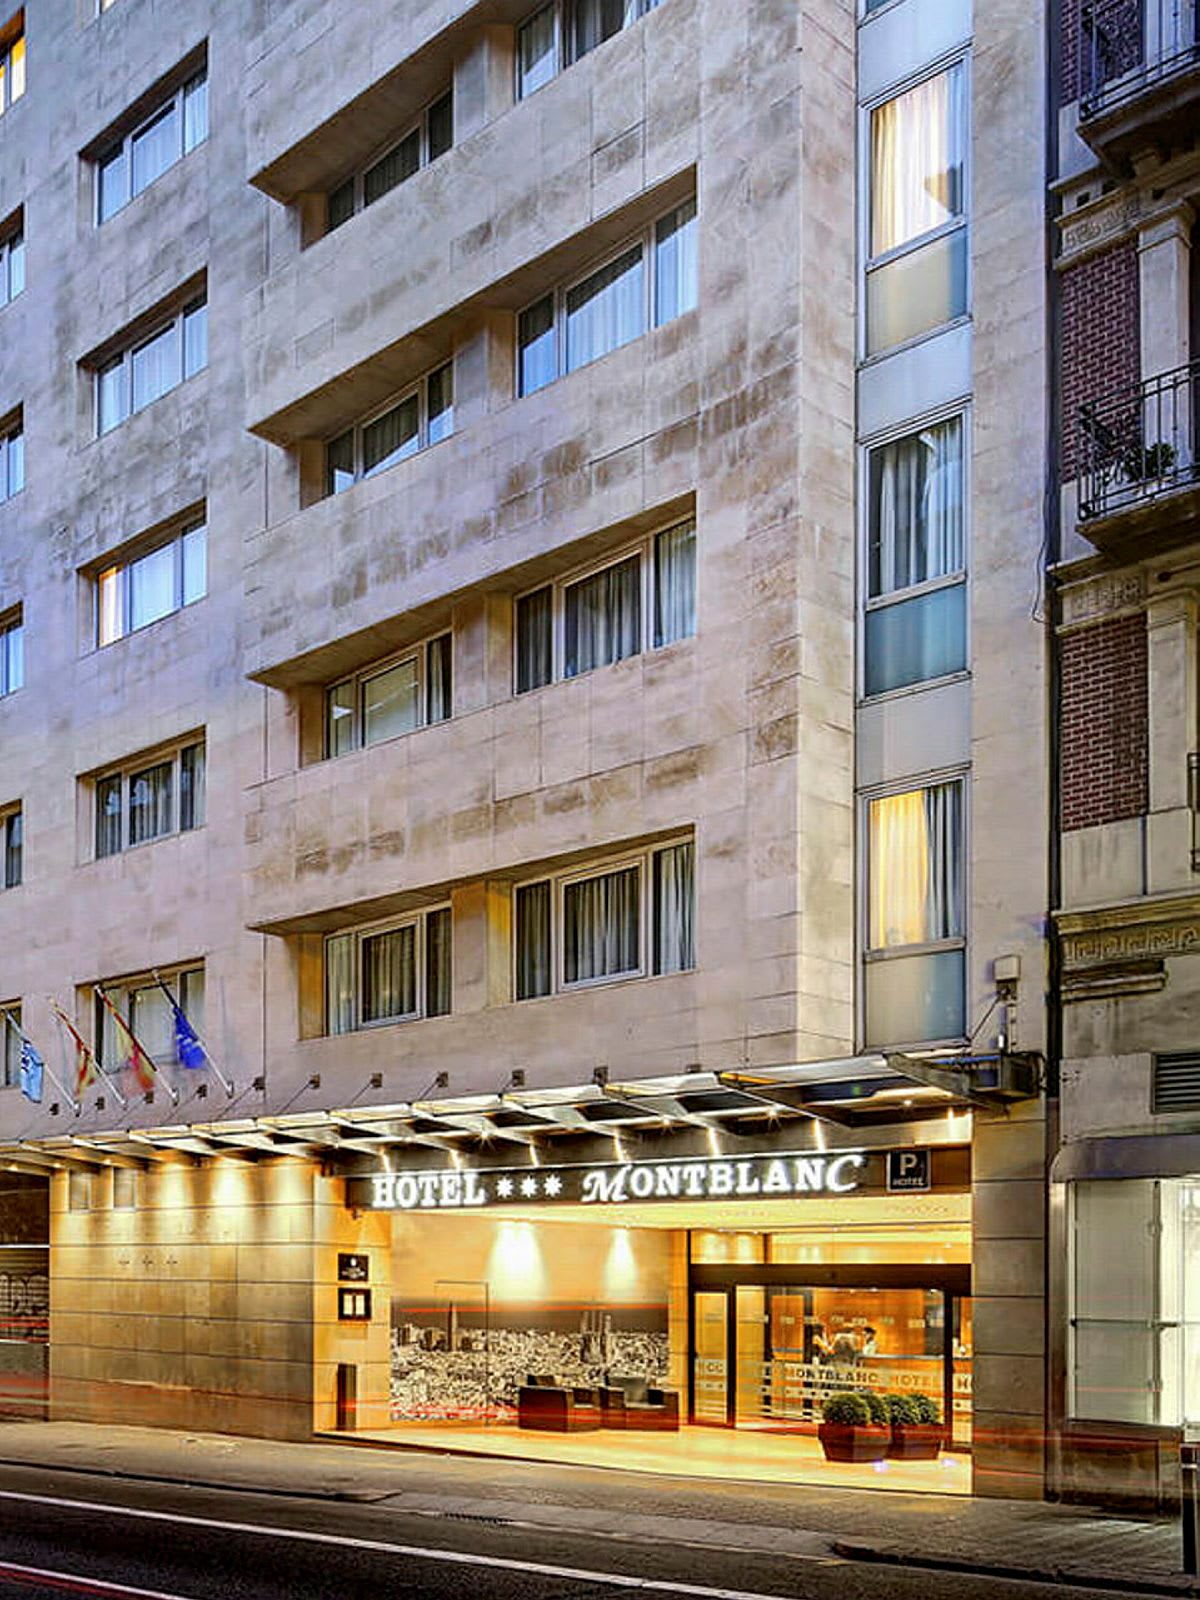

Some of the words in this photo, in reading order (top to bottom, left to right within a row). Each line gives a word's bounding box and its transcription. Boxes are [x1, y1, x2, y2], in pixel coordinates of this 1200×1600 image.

[899, 1152, 918, 1176] P
[371, 1172, 486, 1209] HOTEL
[582, 1154, 865, 1204] MONTBLANC
[892, 1176, 925, 1187] HOTEL
